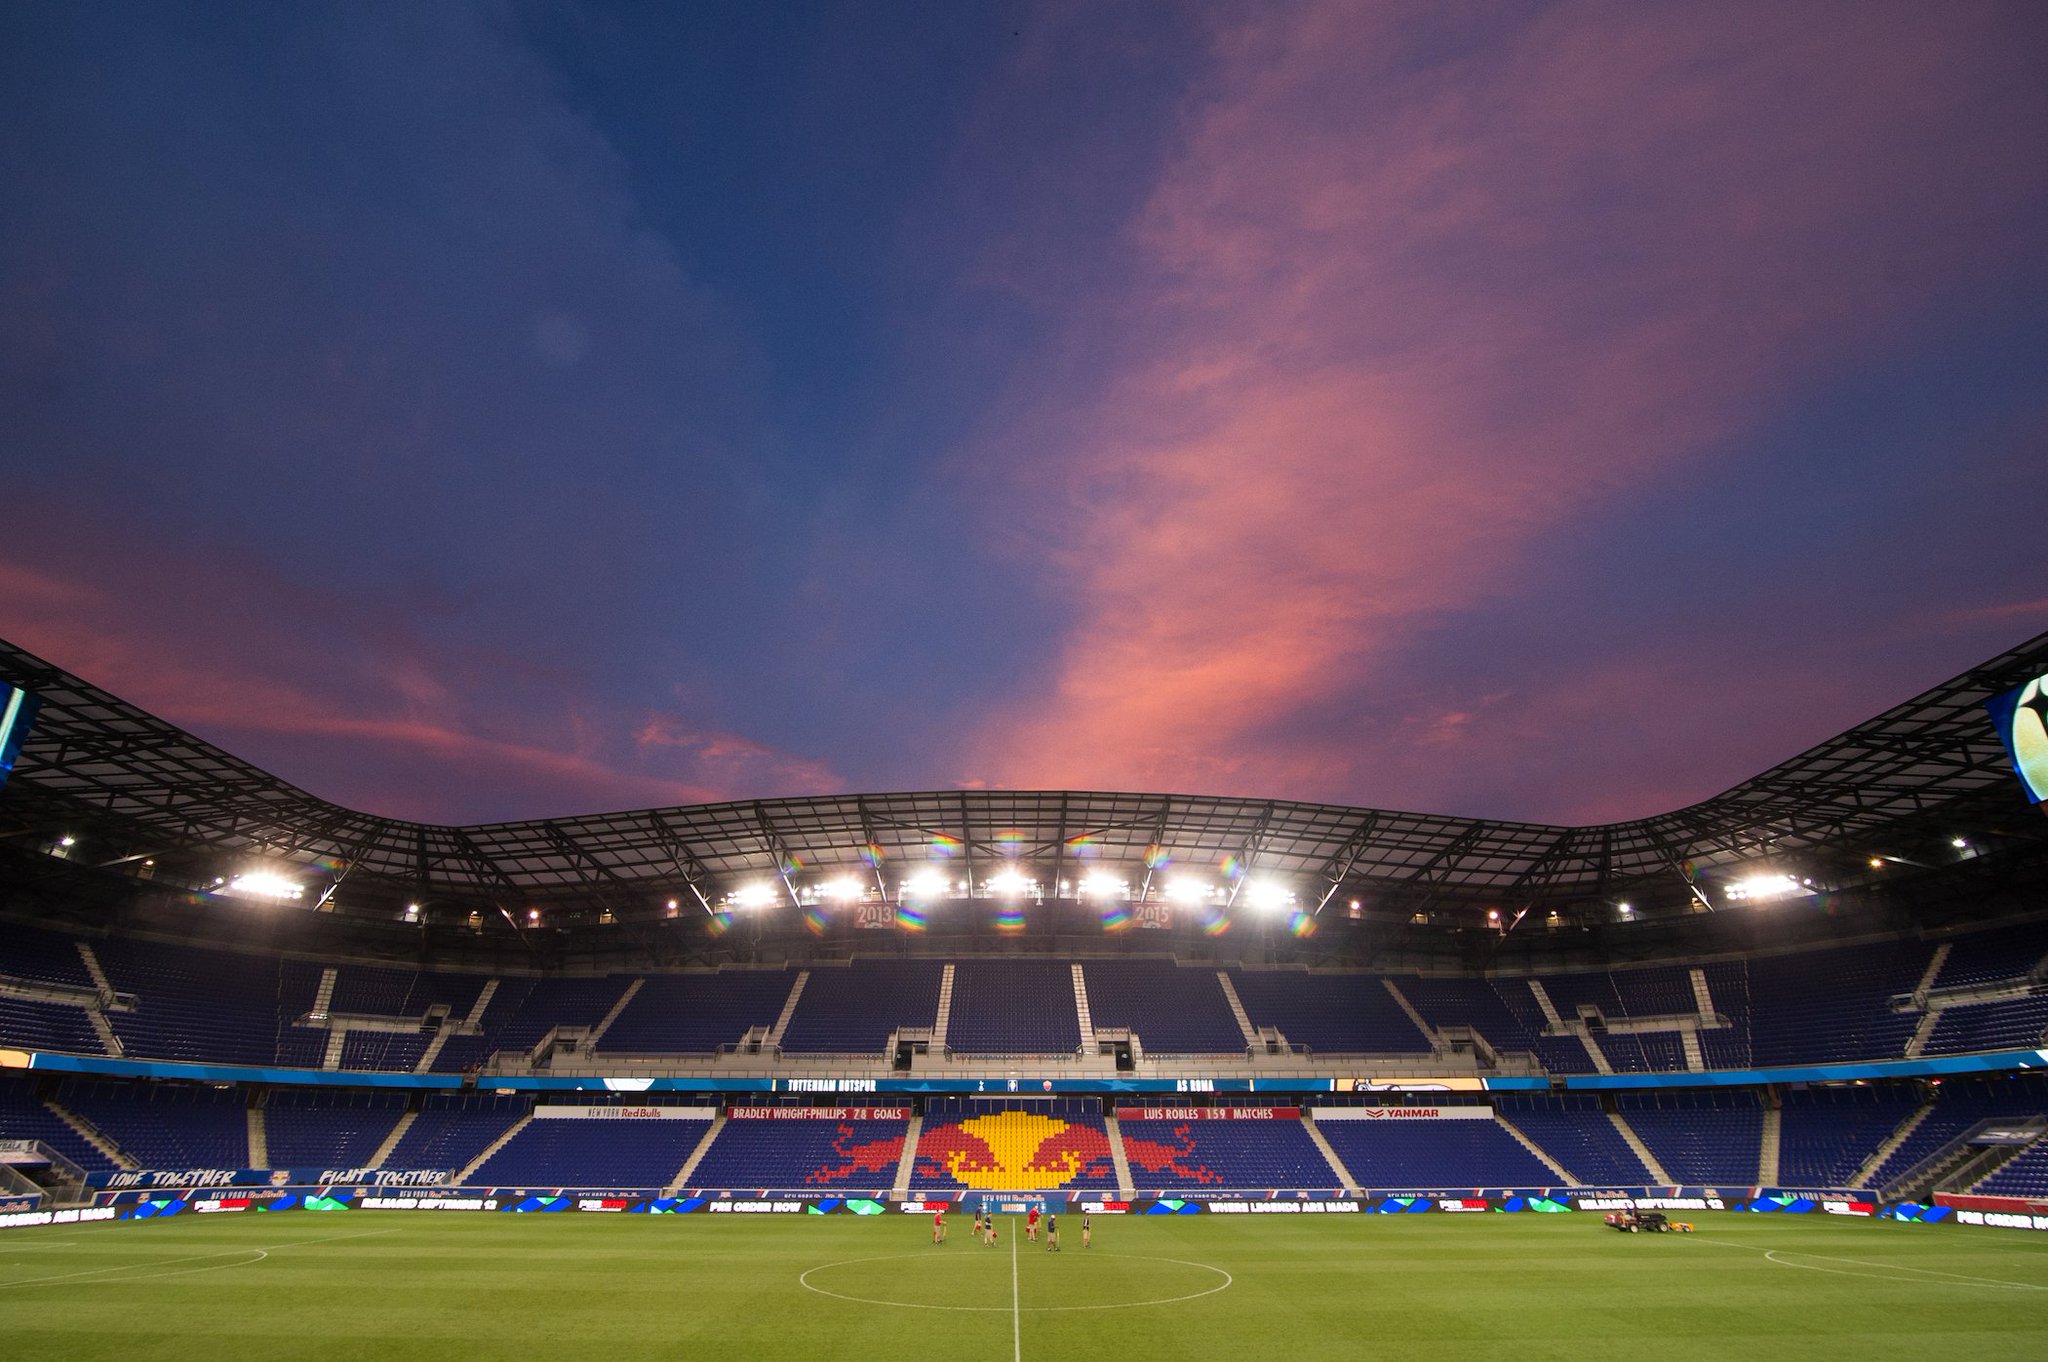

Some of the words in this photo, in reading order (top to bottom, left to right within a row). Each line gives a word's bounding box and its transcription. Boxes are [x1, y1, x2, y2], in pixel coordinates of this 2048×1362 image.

[857, 906, 892, 923] 2013
[1136, 906, 1169, 923] 2015
[788, 1080, 836, 1092] TOTTENHAM
[839, 1080, 876, 1092] HOTSPUR
[1176, 1080, 1188, 1092] AS
[1190, 1080, 1214, 1092] ROMA
[733, 1109, 770, 1119] BRADLEY
[773, 1109, 846, 1119] WRIGHT-PHILLIPS
[873, 1109, 902, 1119] GOALS
[1144, 1109, 1163, 1119] LUIS
[1165, 1109, 1198, 1119] ROBLES
[1206, 1109, 1226, 1119] 159
[1233, 1109, 1273, 1119] MATCHES
[1387, 1109, 1439, 1118] YANMAR
[107, 1171, 147, 1188] LOVE
[152, 1168, 237, 1187] TOGETHER
[319, 1168, 372, 1185] FIGHT
[374, 1169, 447, 1186] TOGETHER
[772, 1202, 801, 1212] NOW
